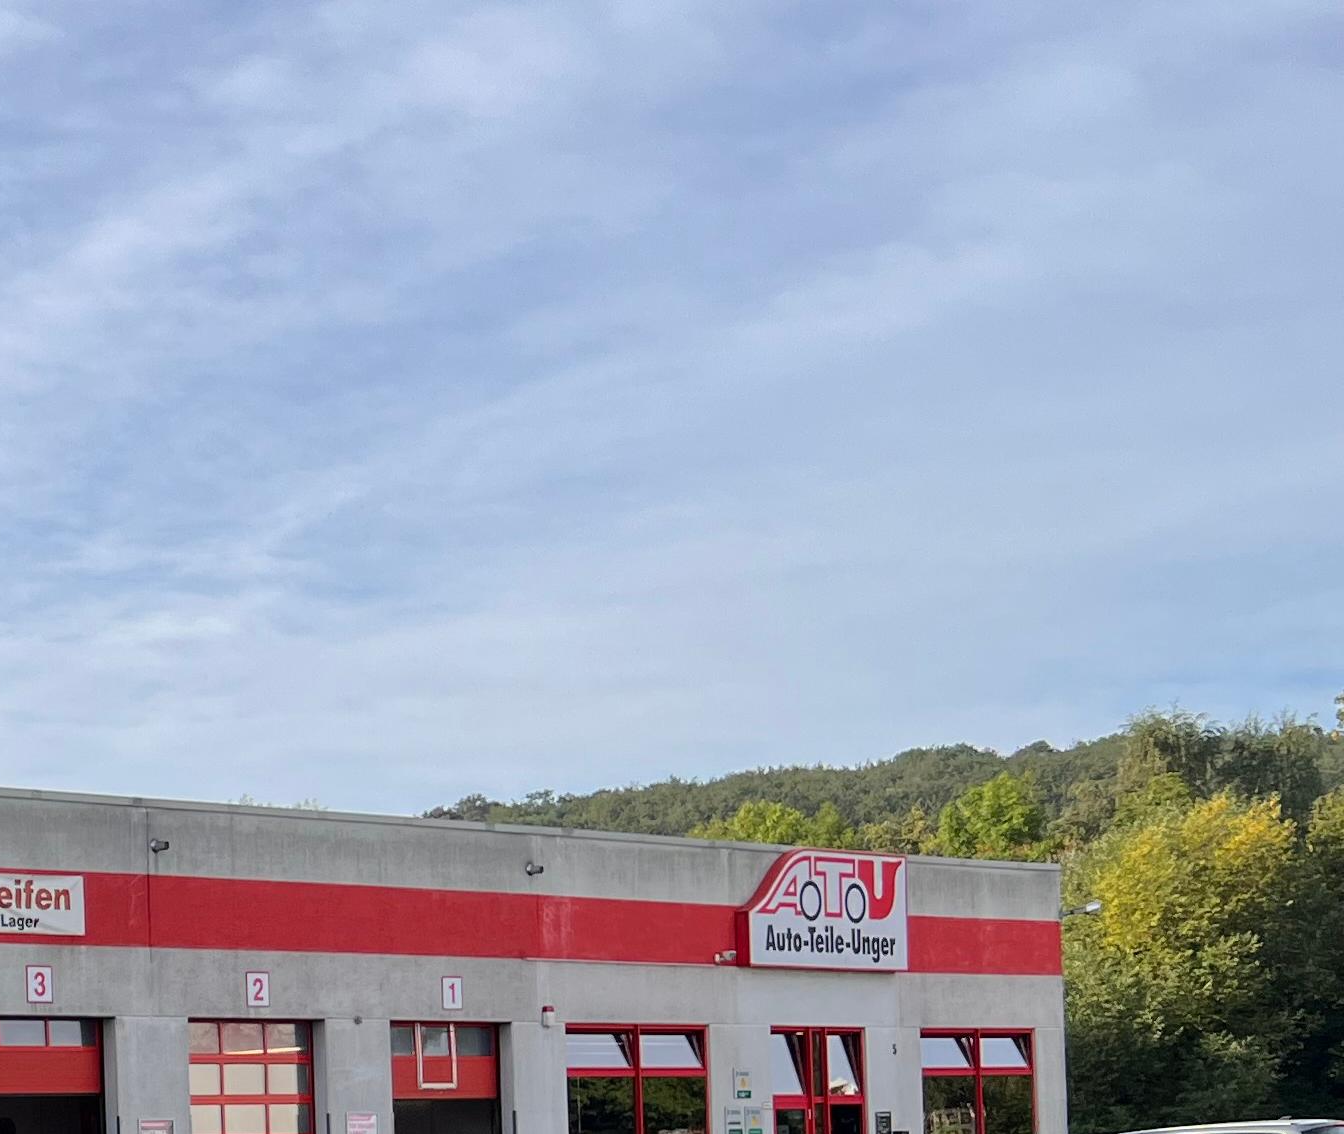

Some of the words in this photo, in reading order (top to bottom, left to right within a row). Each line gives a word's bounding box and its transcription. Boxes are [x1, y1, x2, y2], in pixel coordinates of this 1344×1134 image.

[0, 914, 40, 931] Lager
[765, 924, 896, 964] Auto-Teile-Unger
[33, 972, 46, 997] 3
[252, 978, 264, 1001] 2
[449, 982, 456, 1004] 1
